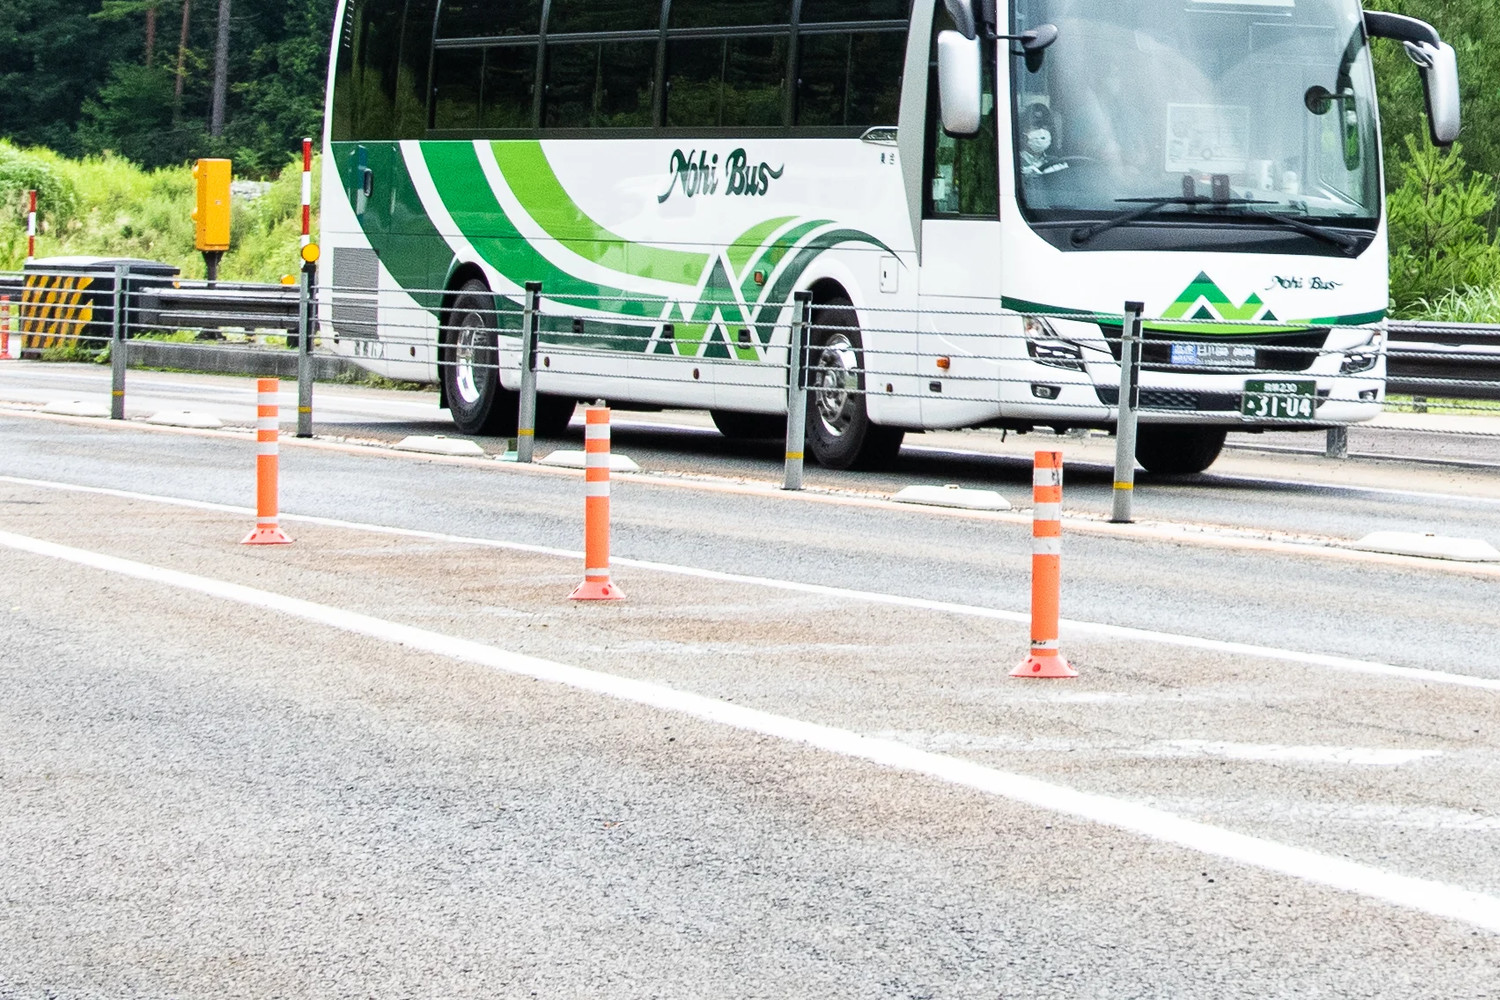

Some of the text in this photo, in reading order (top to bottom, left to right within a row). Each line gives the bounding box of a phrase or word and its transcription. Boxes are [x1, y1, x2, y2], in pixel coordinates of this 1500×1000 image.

[658, 147, 784, 204] Nohi Bus
[1309, 276, 1344, 290] Bus
